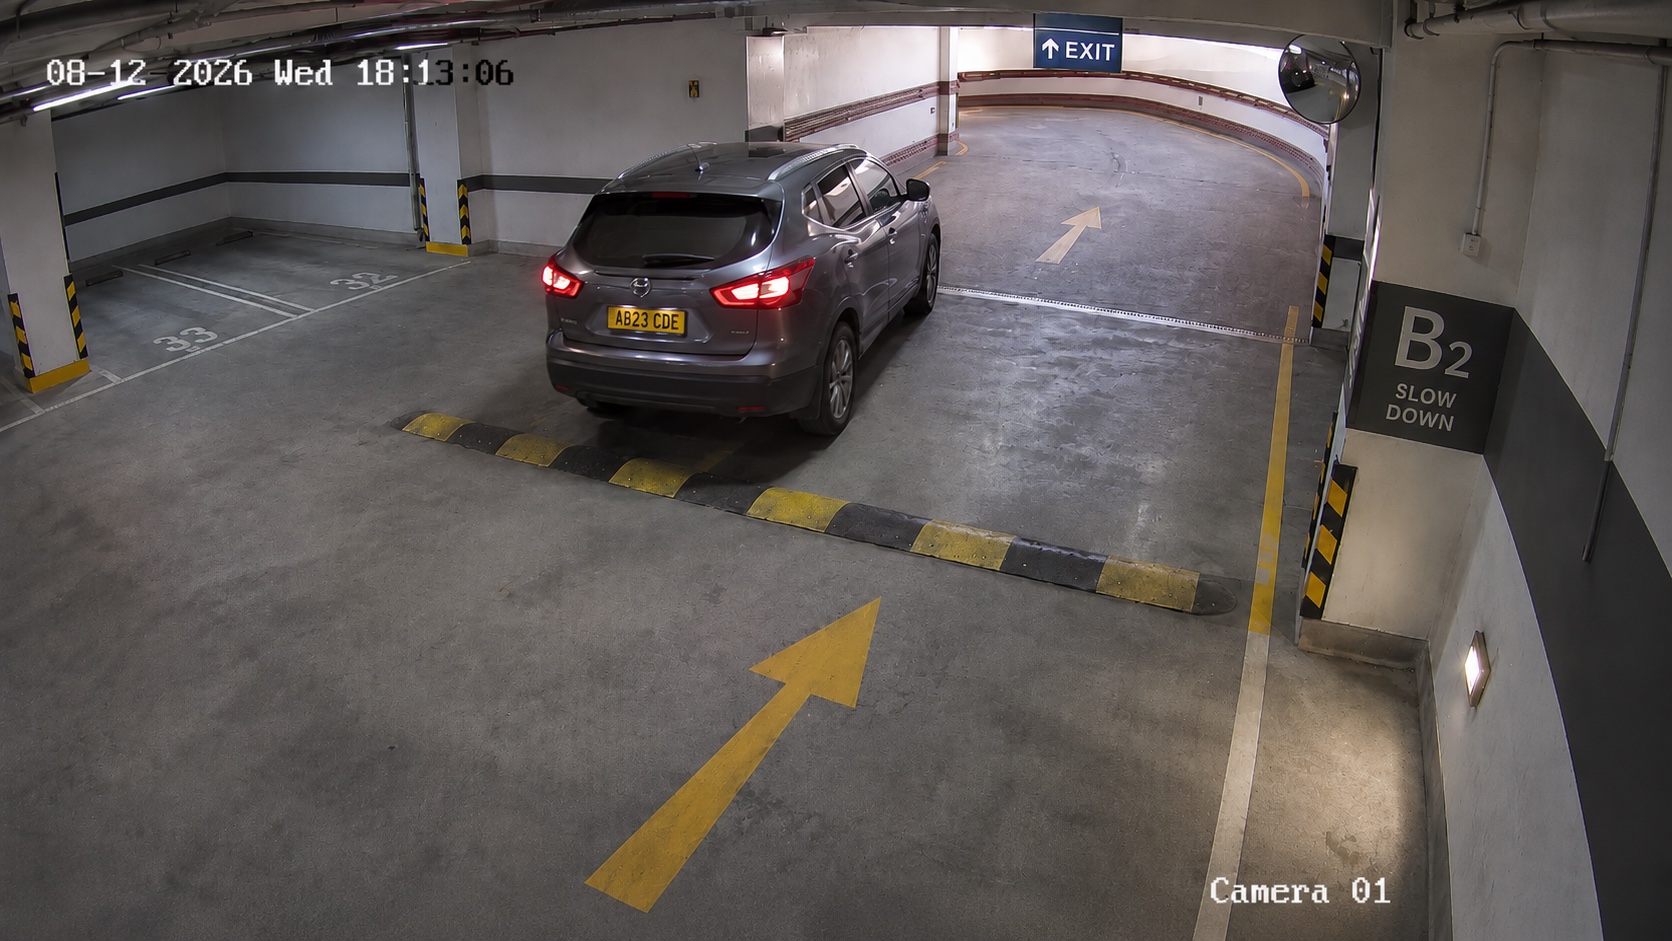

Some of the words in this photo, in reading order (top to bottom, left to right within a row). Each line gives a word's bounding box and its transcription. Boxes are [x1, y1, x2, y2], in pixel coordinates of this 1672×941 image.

[1065, 41, 1115, 61] EXIT
[329, 272, 398, 290] 32
[615, 310, 649, 328] AB23
[653, 313, 679, 330] CDE
[153, 326, 218, 352] 33
[1394, 305, 1473, 379] B2
[1395, 383, 1457, 408] SLOW
[1385, 404, 1455, 432] DOWN
